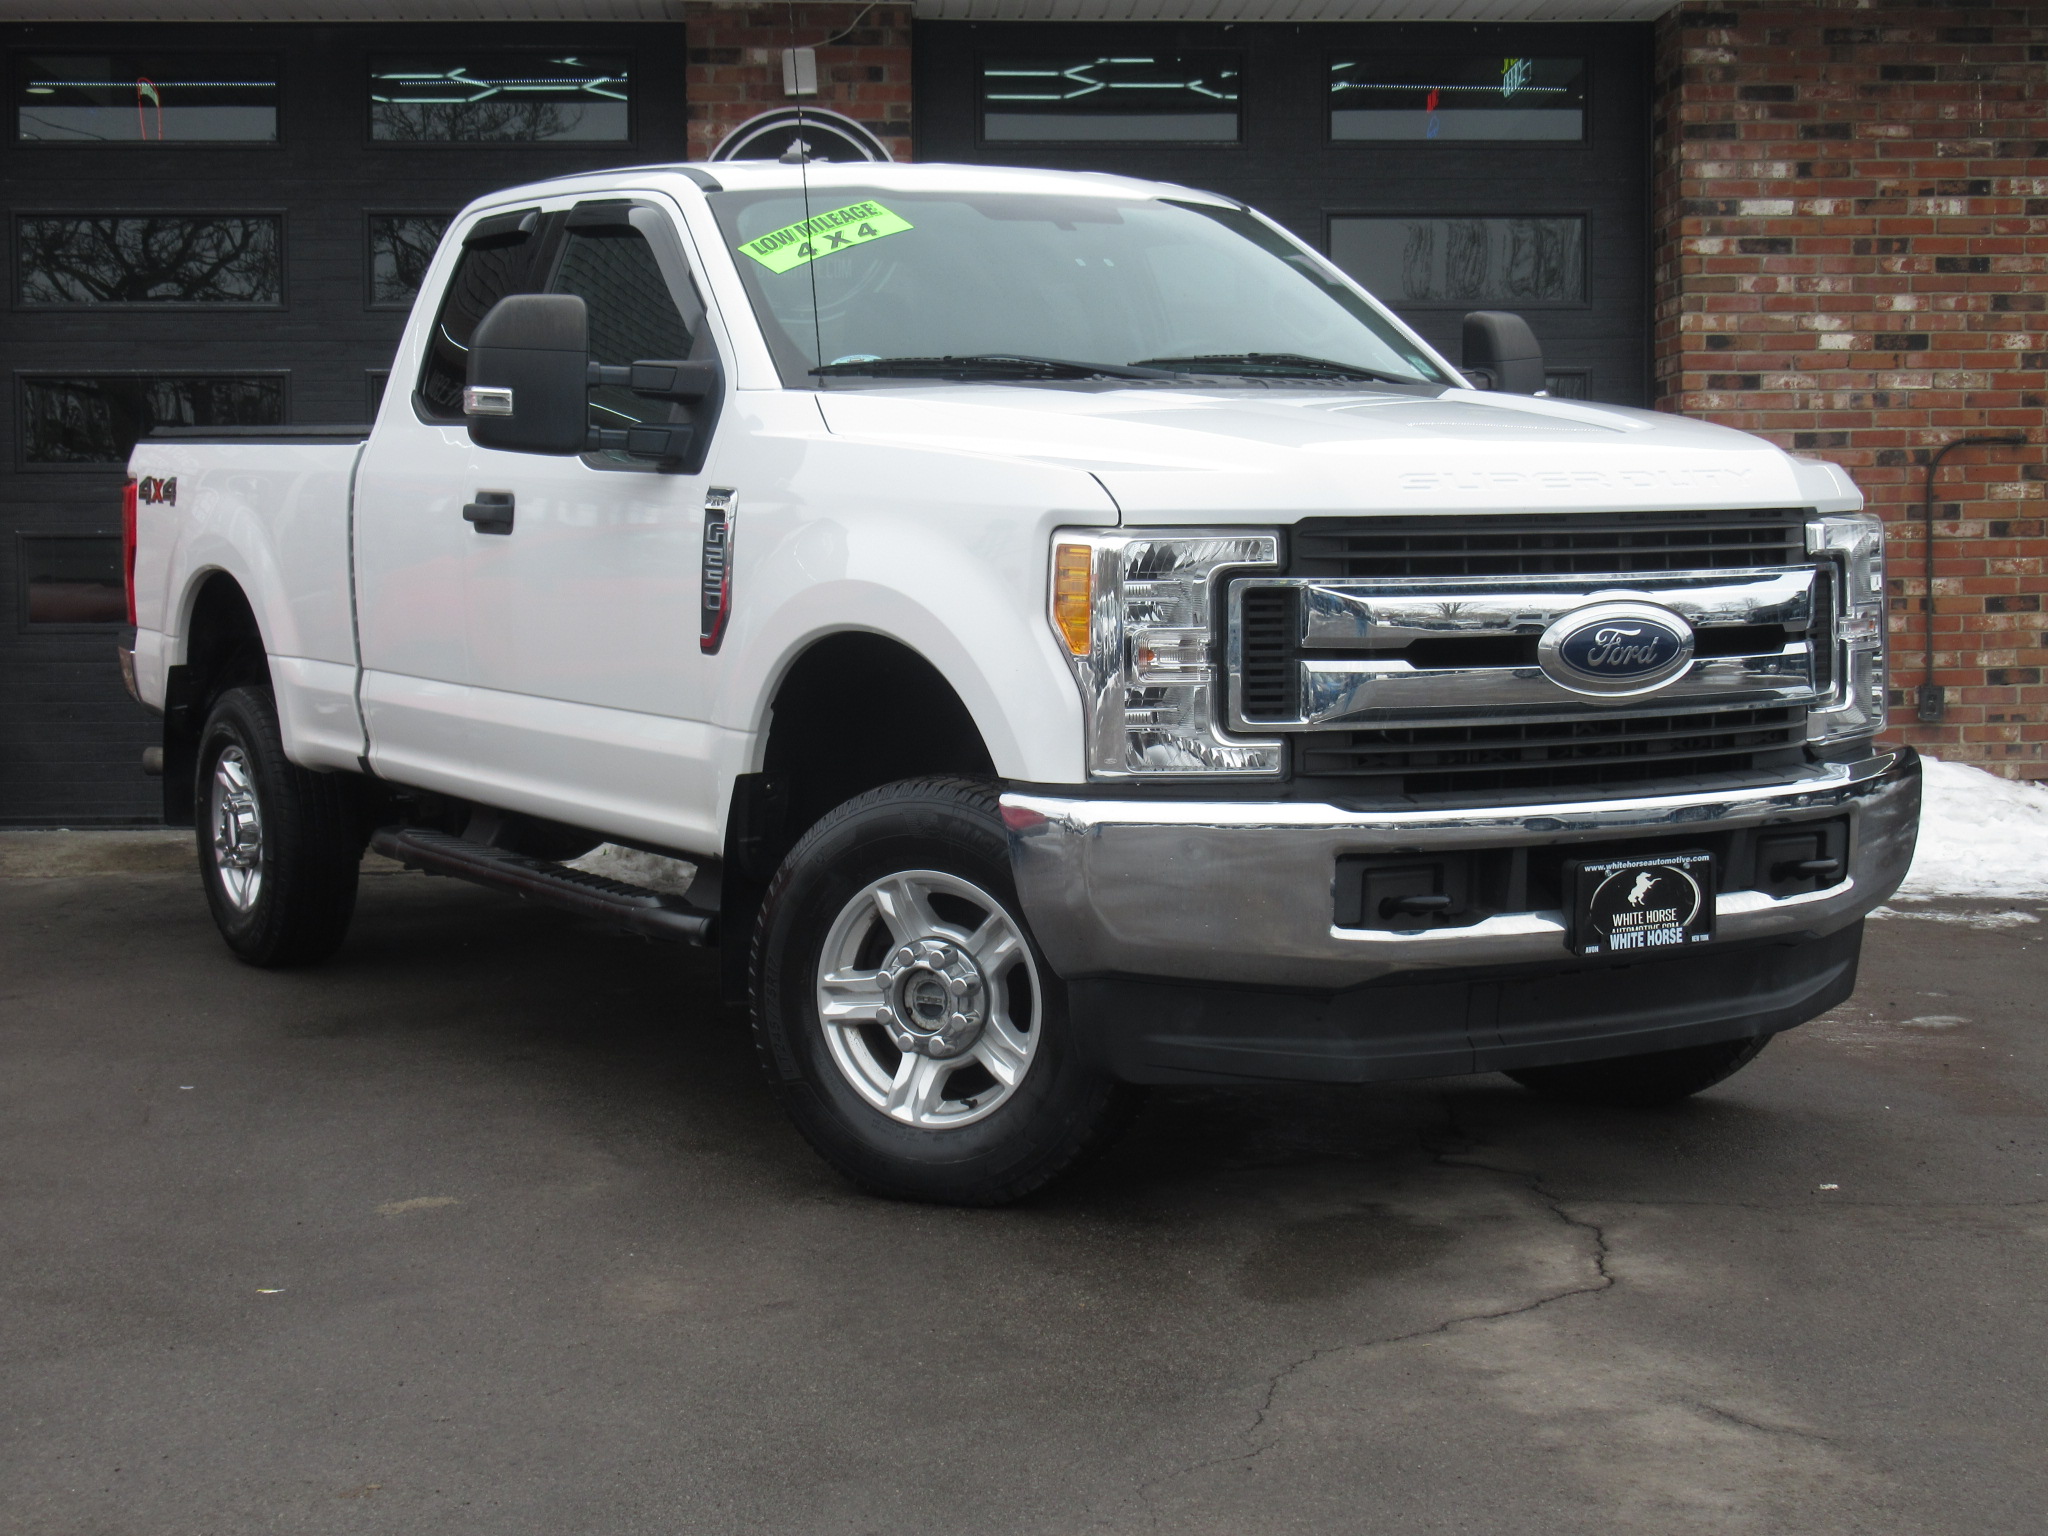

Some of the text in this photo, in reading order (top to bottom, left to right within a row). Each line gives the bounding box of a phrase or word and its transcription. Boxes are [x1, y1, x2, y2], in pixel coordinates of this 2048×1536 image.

[750, 202, 881, 256] LOW MILEAGE
[797, 222, 879, 258] 4 X 4
[1397, 468, 1751, 492] SUPER DUTY
[1587, 627, 1659, 667] Ford
[1584, 854, 1710, 872] www.whitehorseautomotive.com
[1611, 922, 1680, 934] AUTOMOTIVECOM
[1612, 907, 1677, 927] WHITE HORSE
[1610, 927, 1683, 951] WHITE HORSE
